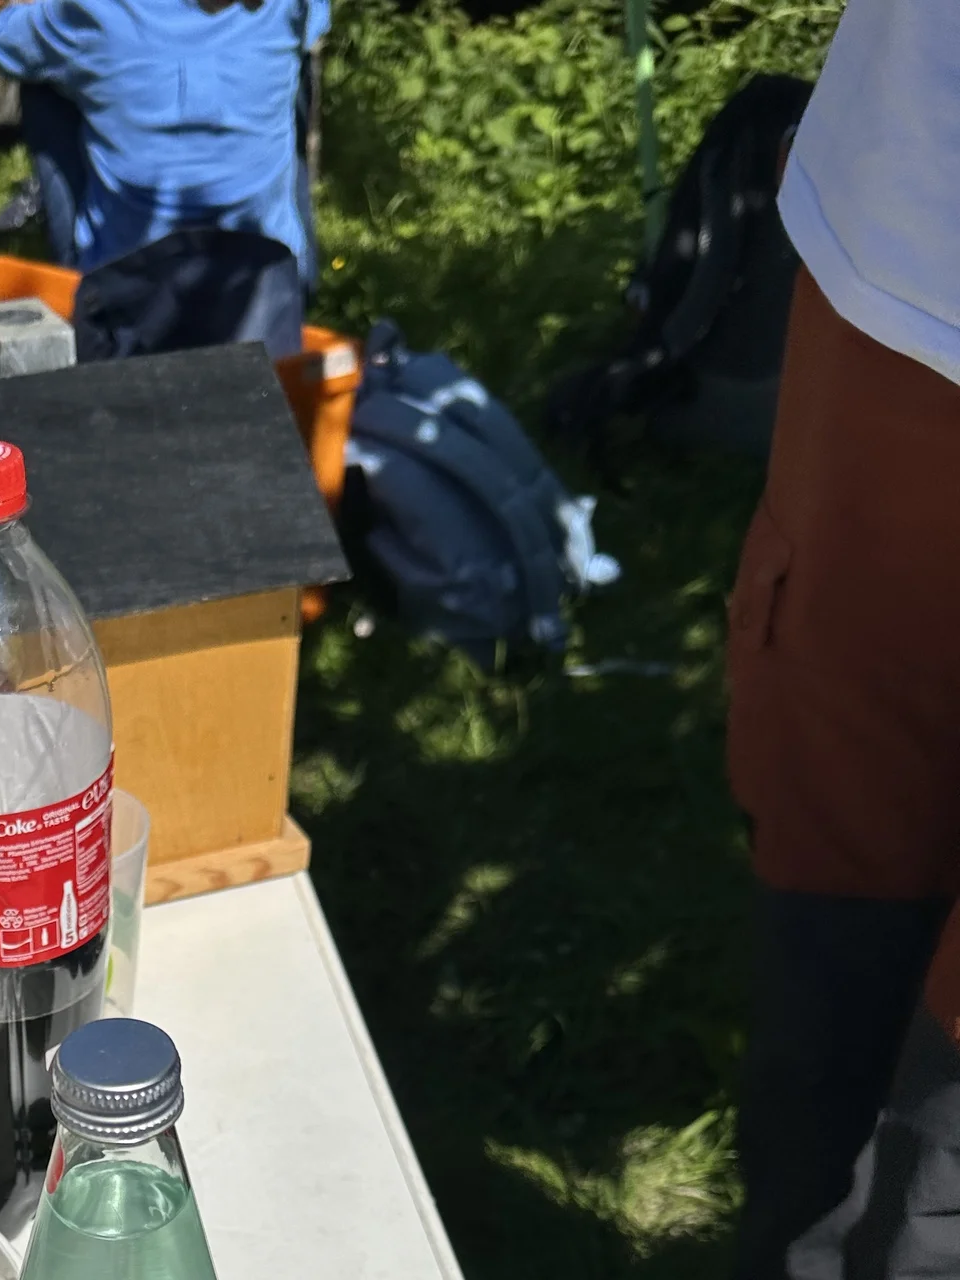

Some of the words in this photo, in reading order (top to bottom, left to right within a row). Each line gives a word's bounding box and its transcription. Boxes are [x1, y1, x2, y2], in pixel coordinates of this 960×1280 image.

[42, 802, 81, 821] ORIGINAL
[44, 814, 70, 828] TASTE
[65, 931, 74, 946] 5
